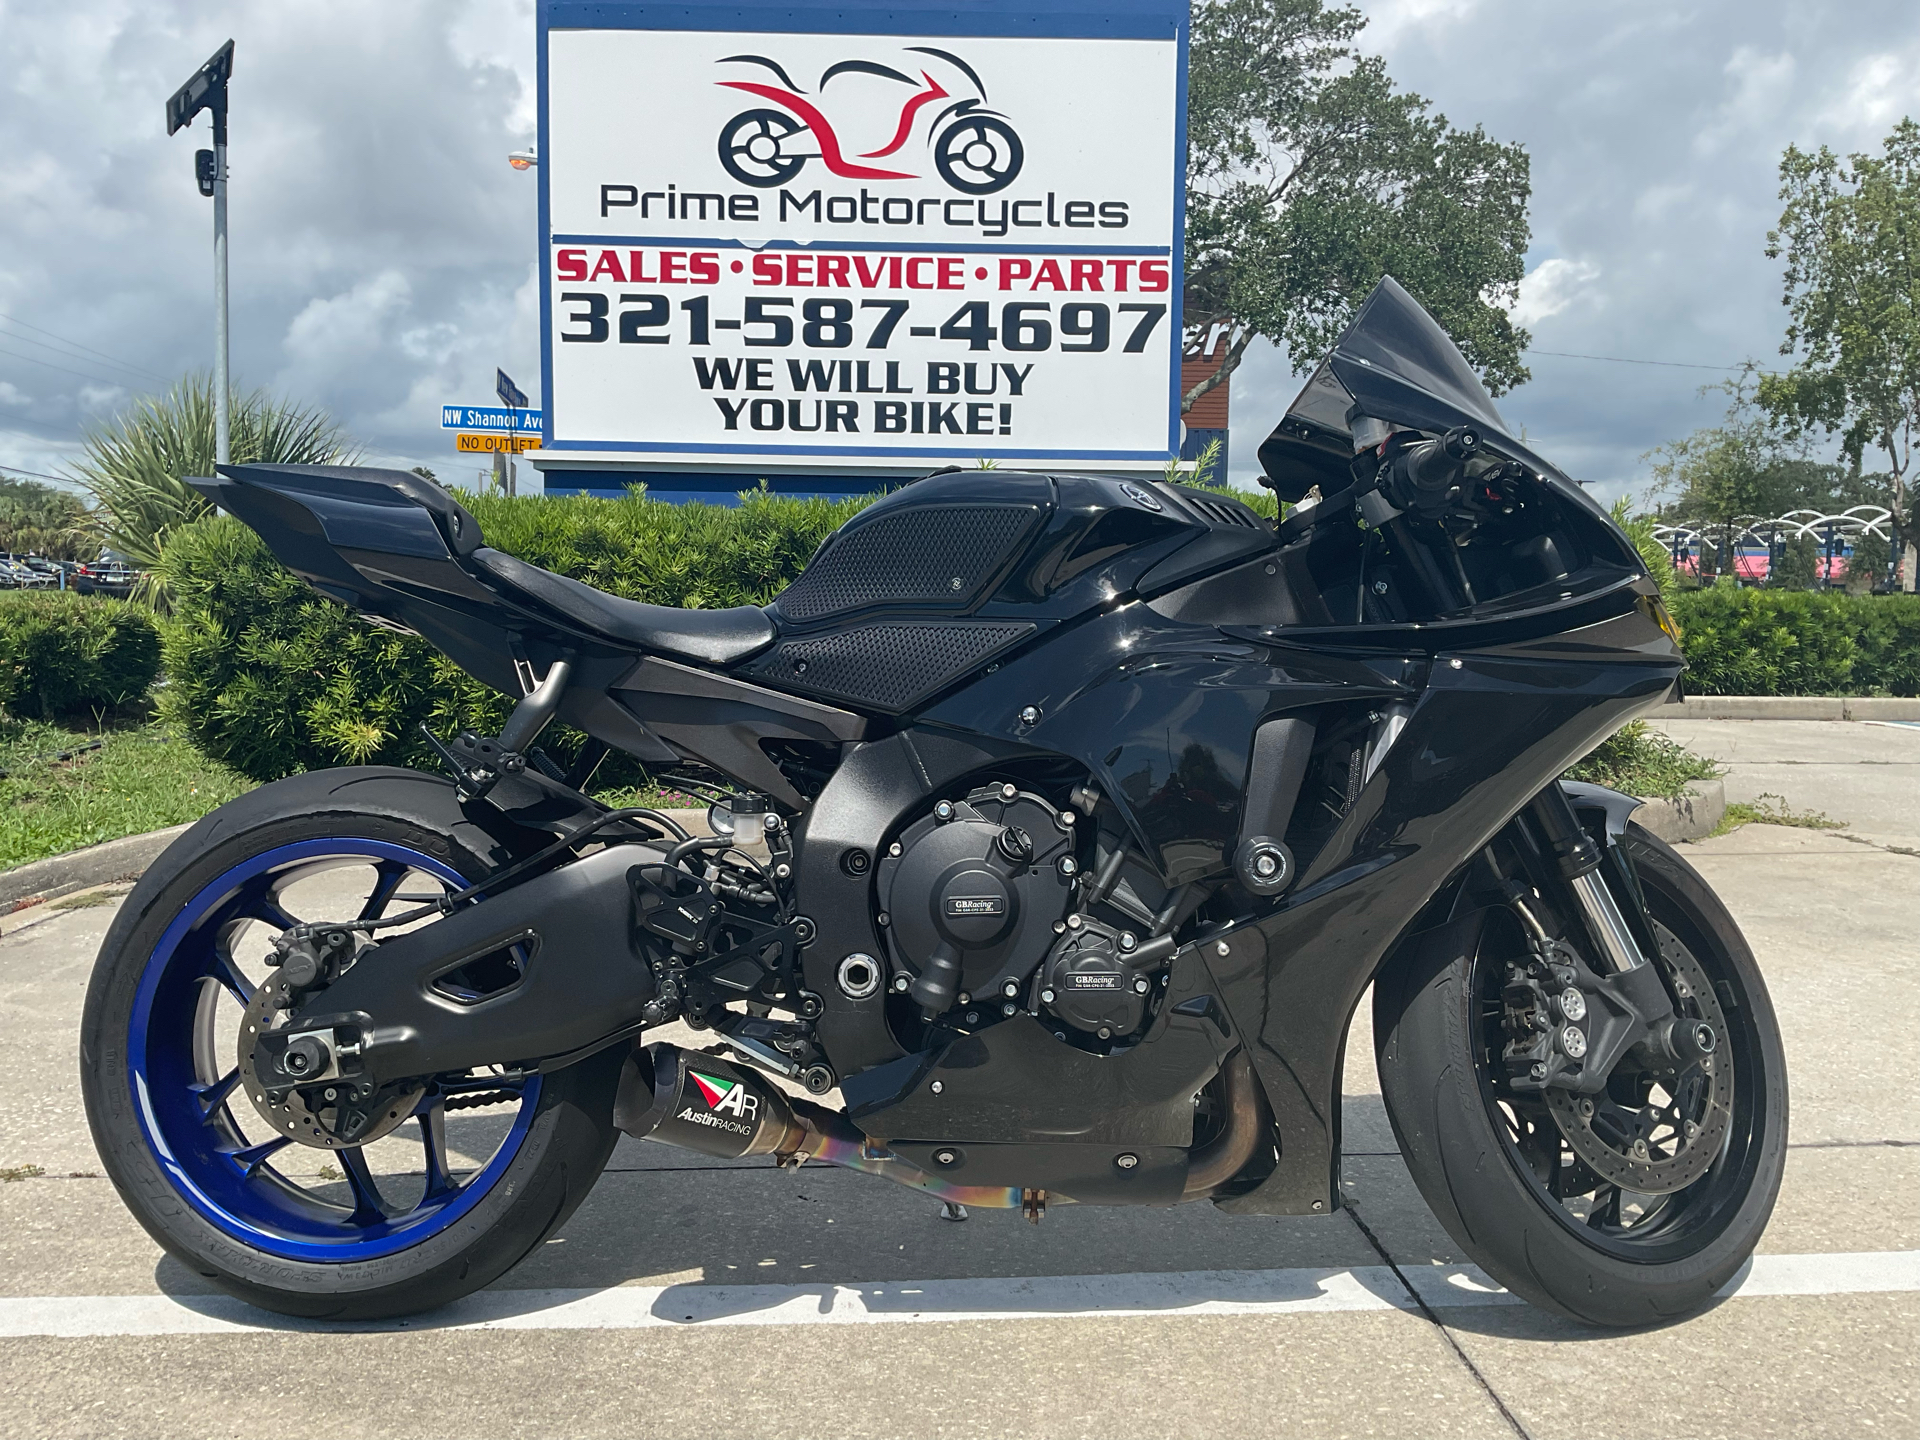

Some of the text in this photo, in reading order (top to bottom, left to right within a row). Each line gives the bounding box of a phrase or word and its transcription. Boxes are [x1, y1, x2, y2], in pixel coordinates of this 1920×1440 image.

[601, 183, 1129, 237] Prime Motorcycles
[557, 249, 1169, 293] SALES SERVICE PARTS
[560, 292, 1167, 354] 321-587-4697
[692, 356, 1035, 396] WE WILL BUY
[444, 409, 462, 425] NW
[467, 410, 518, 428] Shannon
[712, 397, 1012, 436] YOUR BIKE!
[461, 436, 535, 451] NO OUTLET
